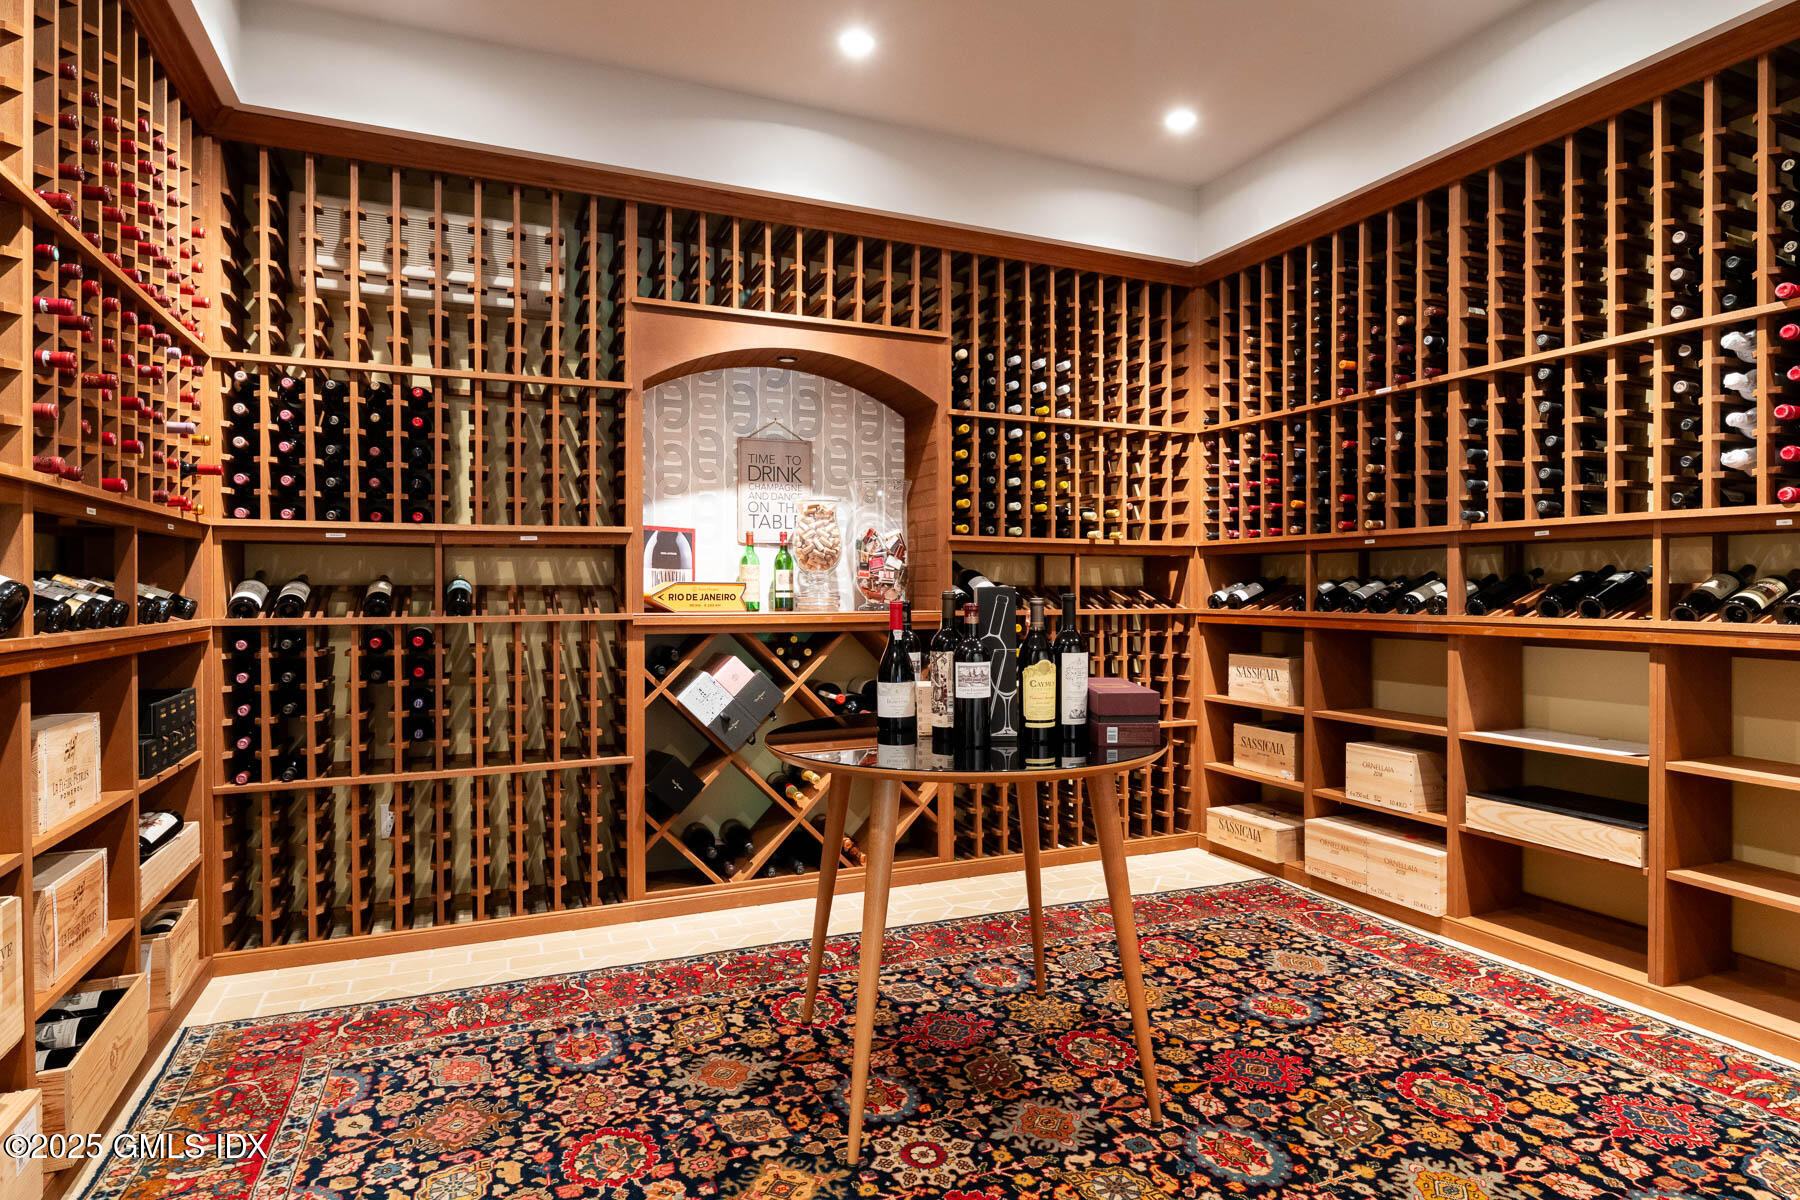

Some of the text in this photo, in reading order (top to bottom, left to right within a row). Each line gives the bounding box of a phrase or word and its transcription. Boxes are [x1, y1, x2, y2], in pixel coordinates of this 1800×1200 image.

[748, 453, 802, 466] TIME TO
[748, 465, 802, 483] DRINK
[749, 483, 802, 492] CHAMPAGNE
[748, 491, 769, 501] AND
[748, 501, 798, 513] ON TH
[668, 593, 737, 602] RIO DE JANEIRO
[1236, 666, 1280, 682] SASSICAIA
[1241, 735, 1286, 756] SASSICAIA
[1362, 761, 1395, 774] ORNELLAIA
[1218, 817, 1262, 843] SASSICAIA
